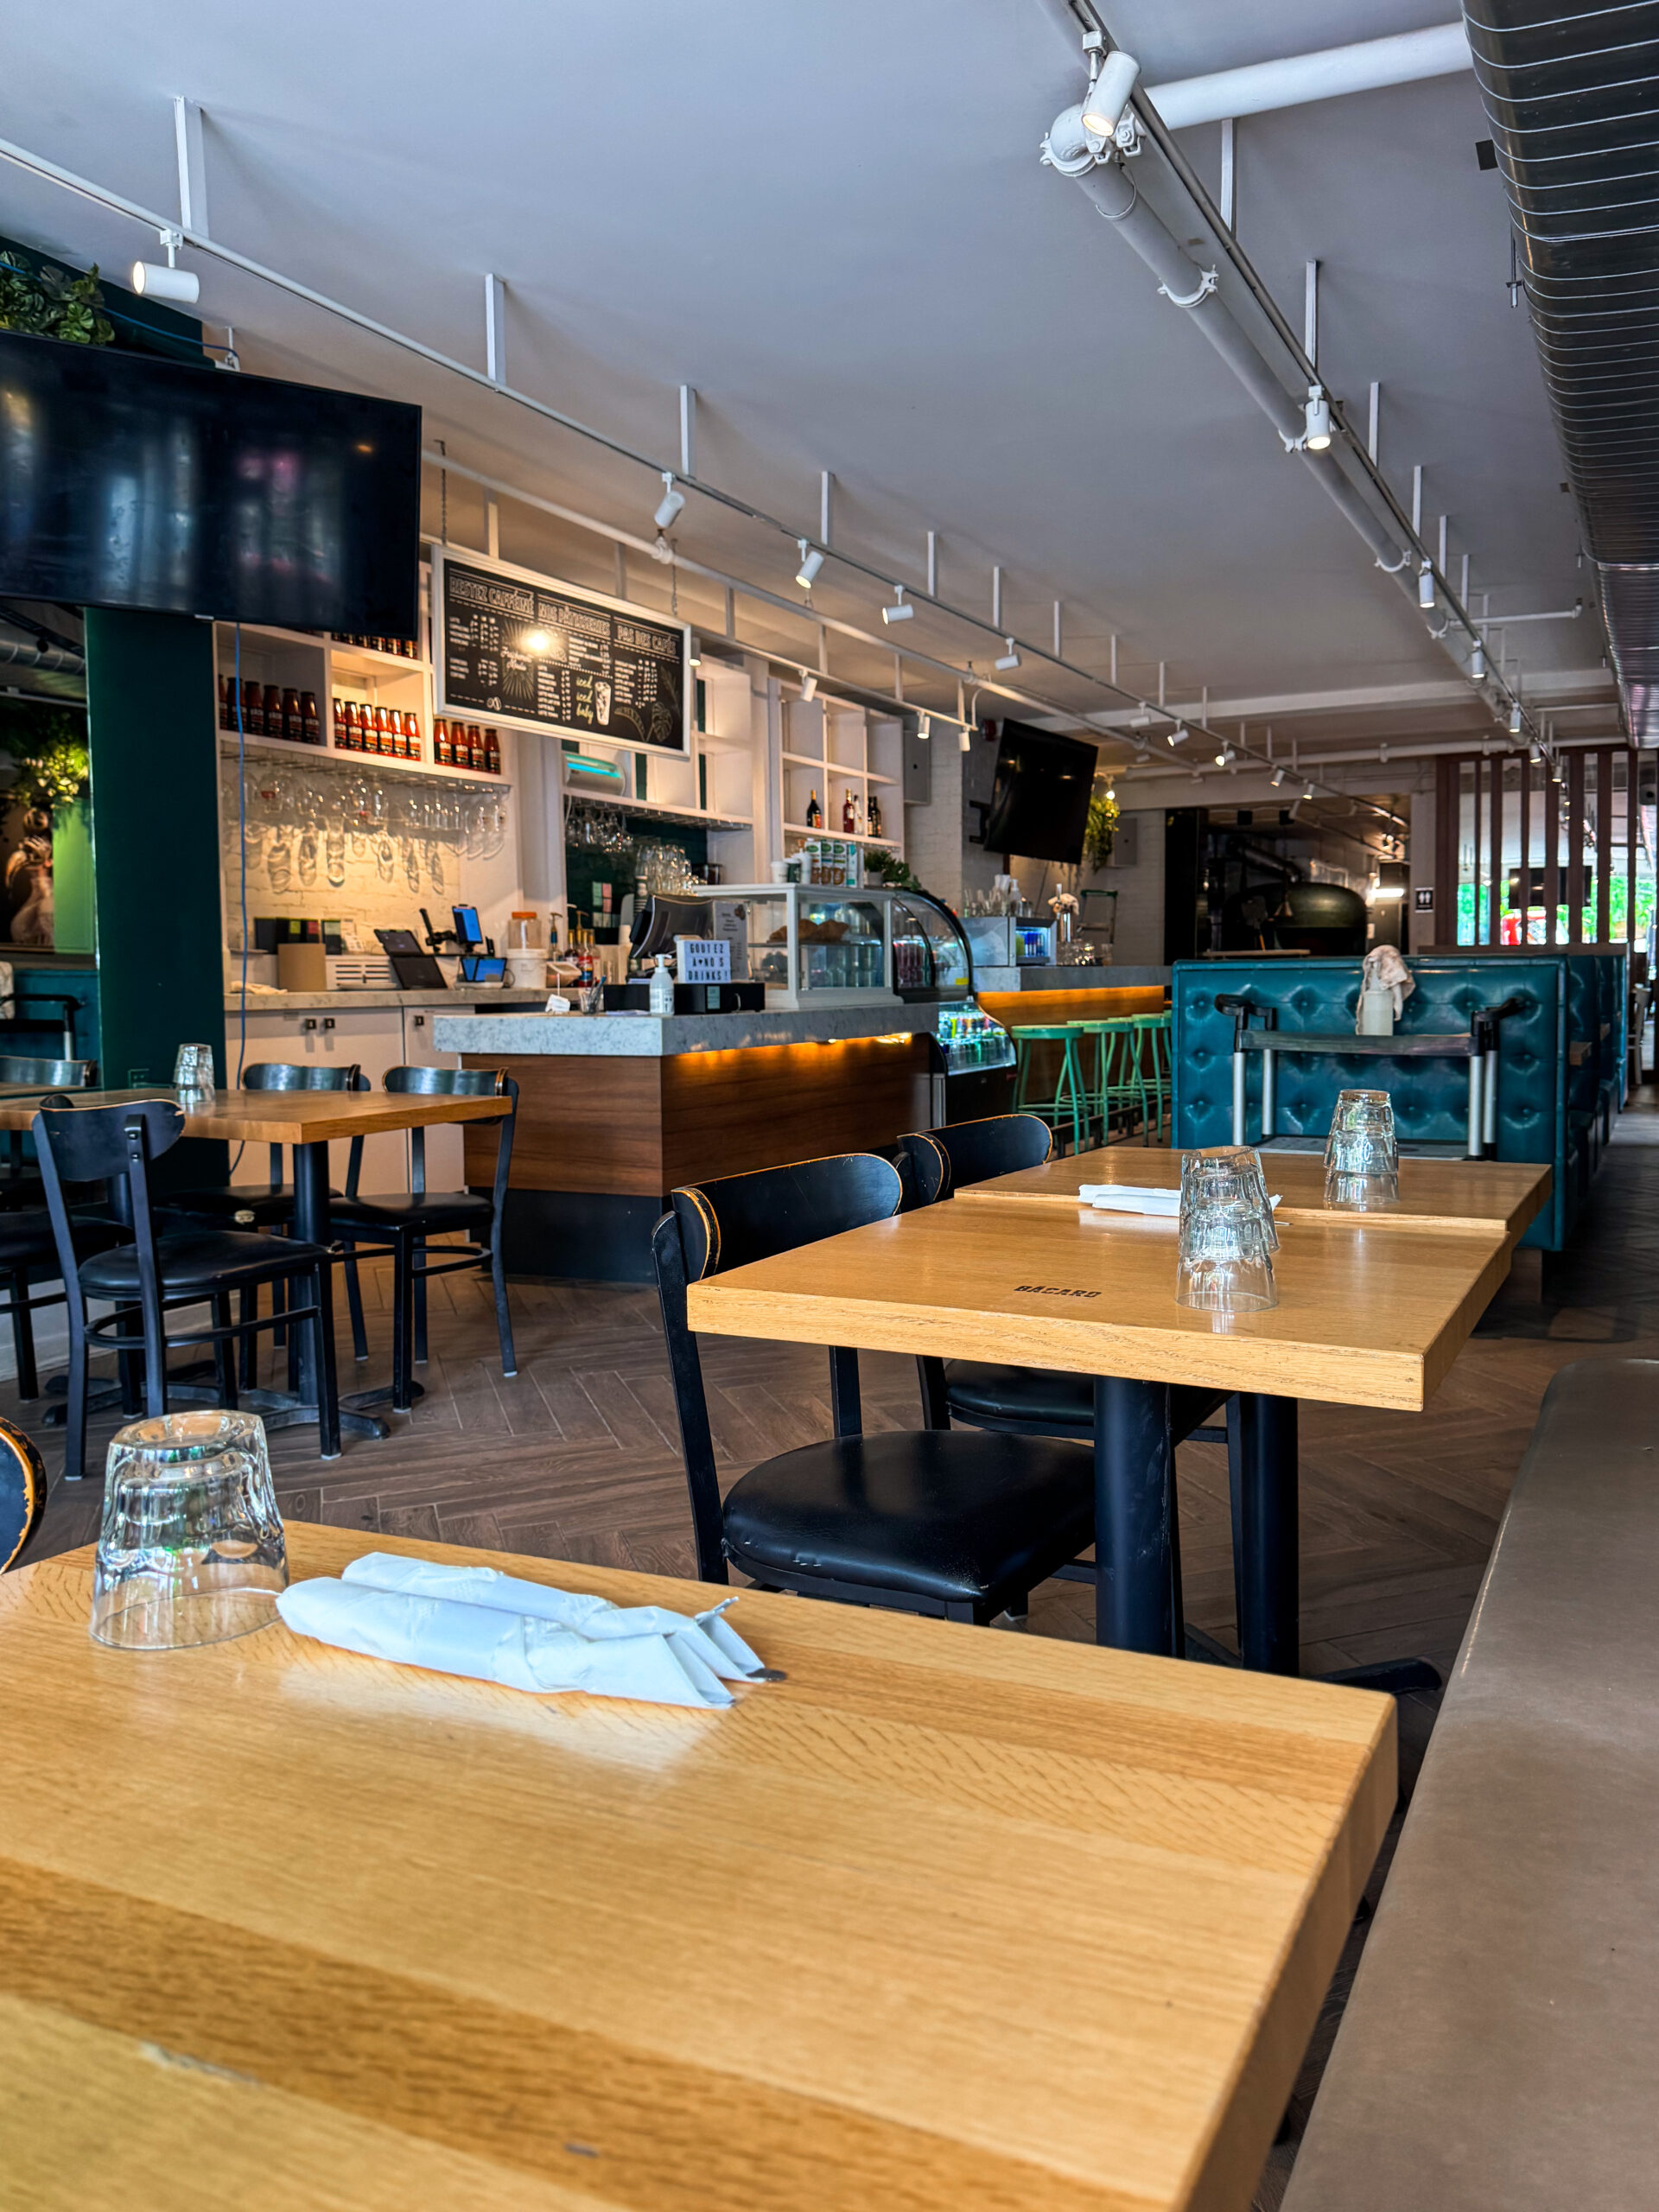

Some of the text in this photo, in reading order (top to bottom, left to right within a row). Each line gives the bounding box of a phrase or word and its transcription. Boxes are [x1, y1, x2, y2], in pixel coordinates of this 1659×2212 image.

[575, 675, 594, 689] iced
[575, 690, 594, 703] iced
[576, 702, 594, 725] baby
